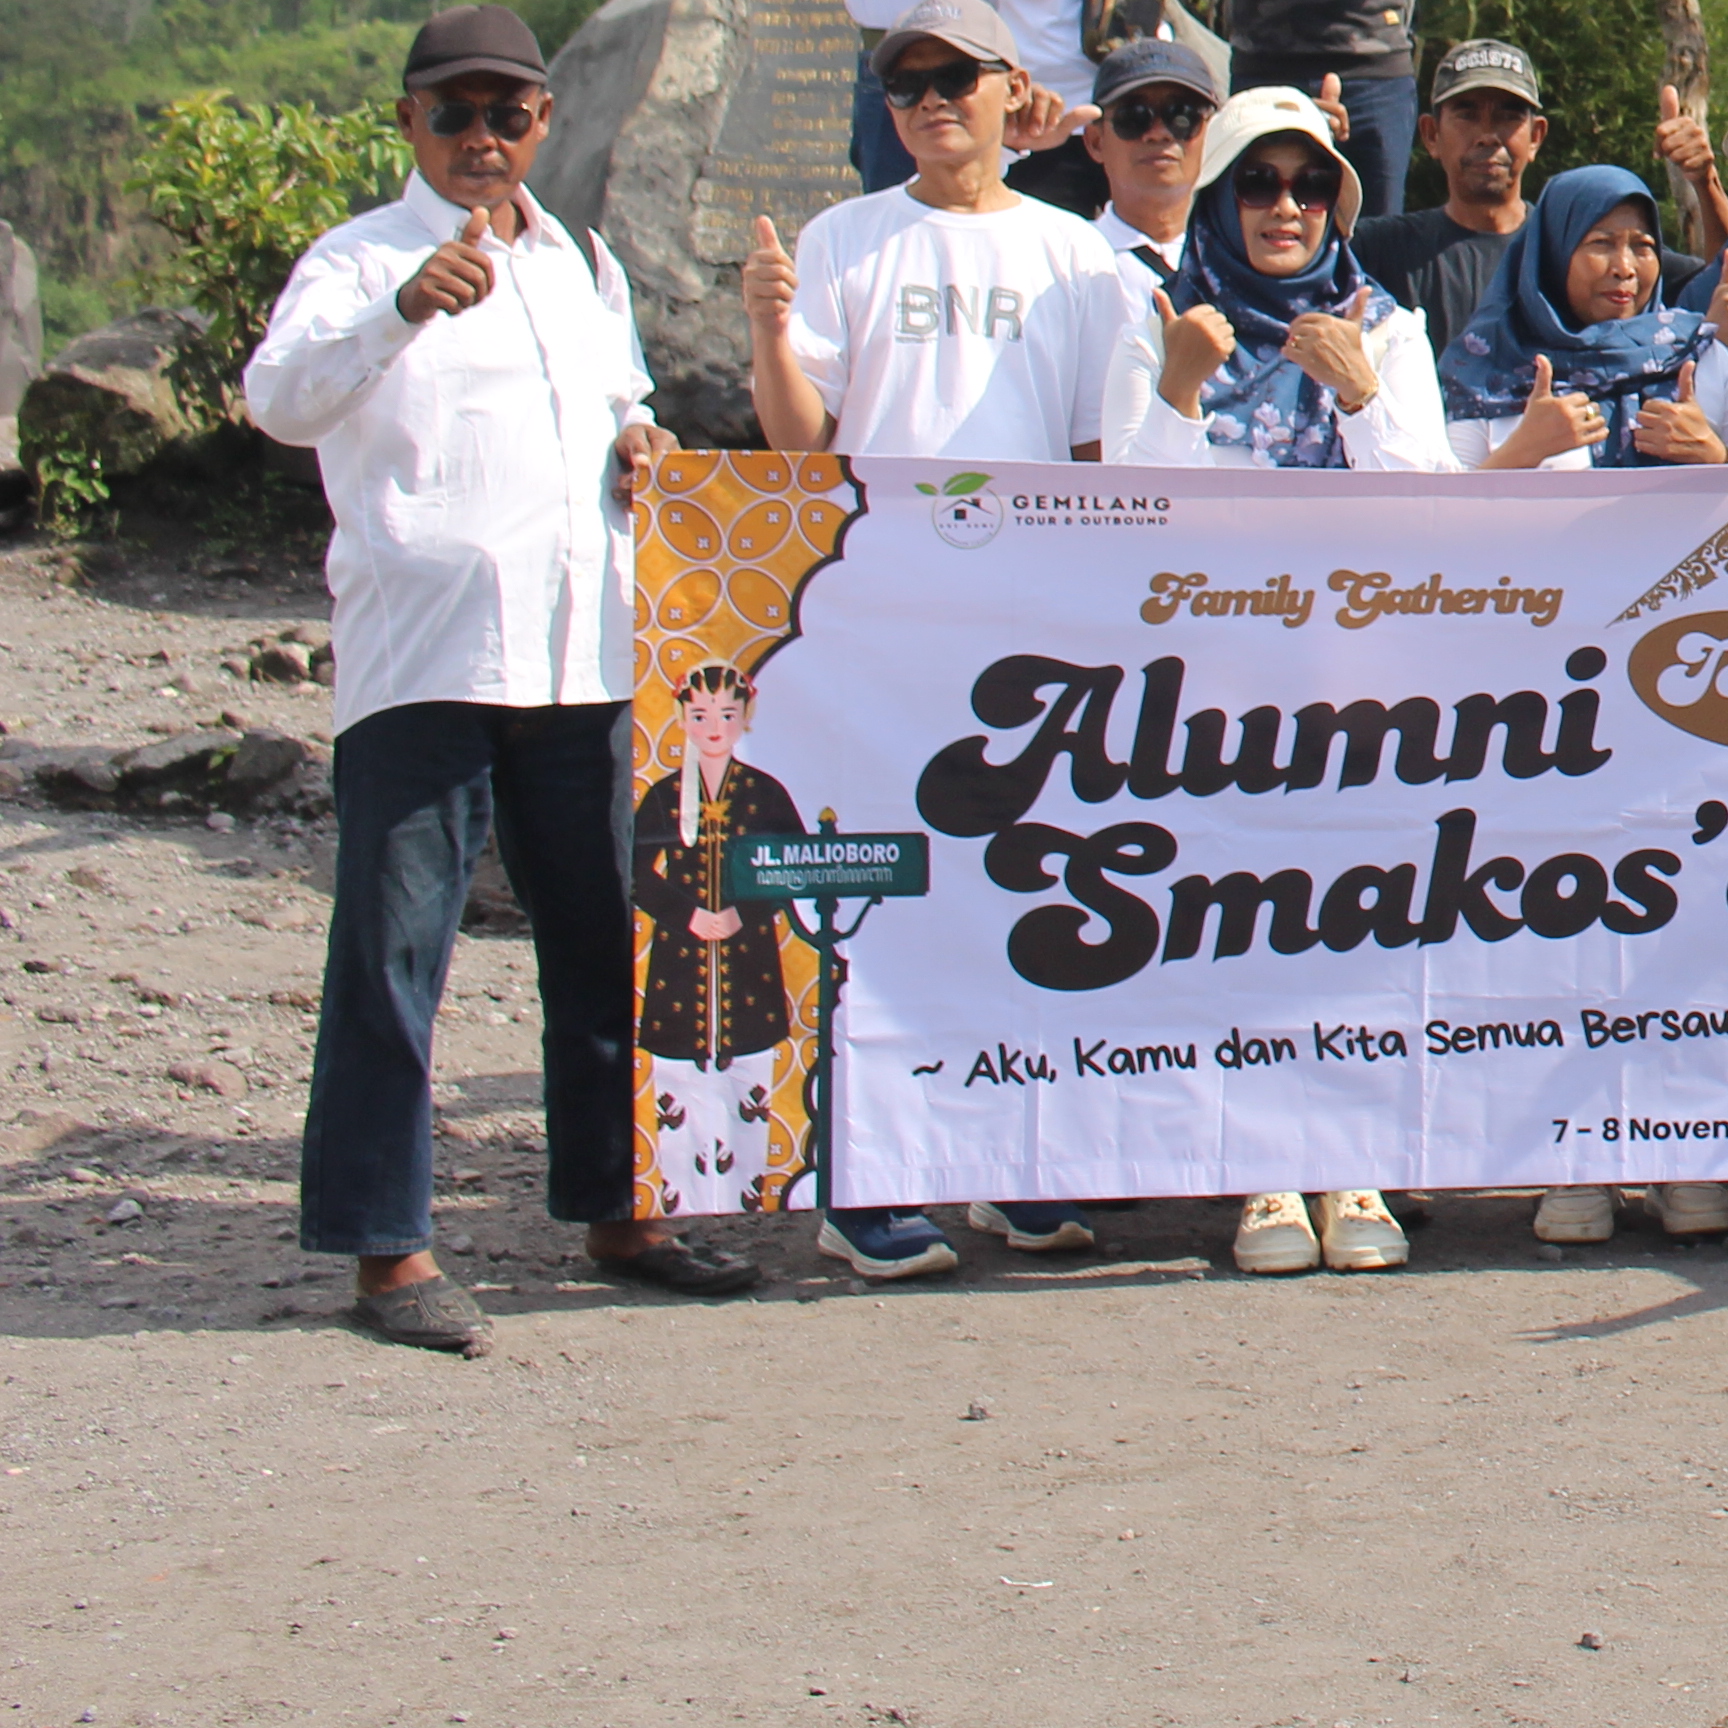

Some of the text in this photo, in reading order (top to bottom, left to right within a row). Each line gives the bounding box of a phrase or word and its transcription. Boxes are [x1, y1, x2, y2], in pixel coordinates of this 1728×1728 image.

[897, 284, 1024, 342] BNR
[1012, 494, 1171, 512] GEMILANG
[1015, 516, 1057, 527] TOUR
[1080, 516, 1168, 527] OUTBOUND
[1139, 569, 1563, 629] Family Gathering
[915, 645, 1612, 839] Alumni
[750, 842, 900, 867] JL. MALIOBORO
[964, 1042, 1057, 1088] Aku,
[1073, 1036, 1197, 1078] Kamu
[1214, 1026, 1297, 1071] dan
[1313, 1021, 1408, 1064] Kita
[1424, 1019, 1564, 1056] Semua
[1551, 1118, 1569, 1144] 7
[1601, 1117, 1621, 1143] 8
